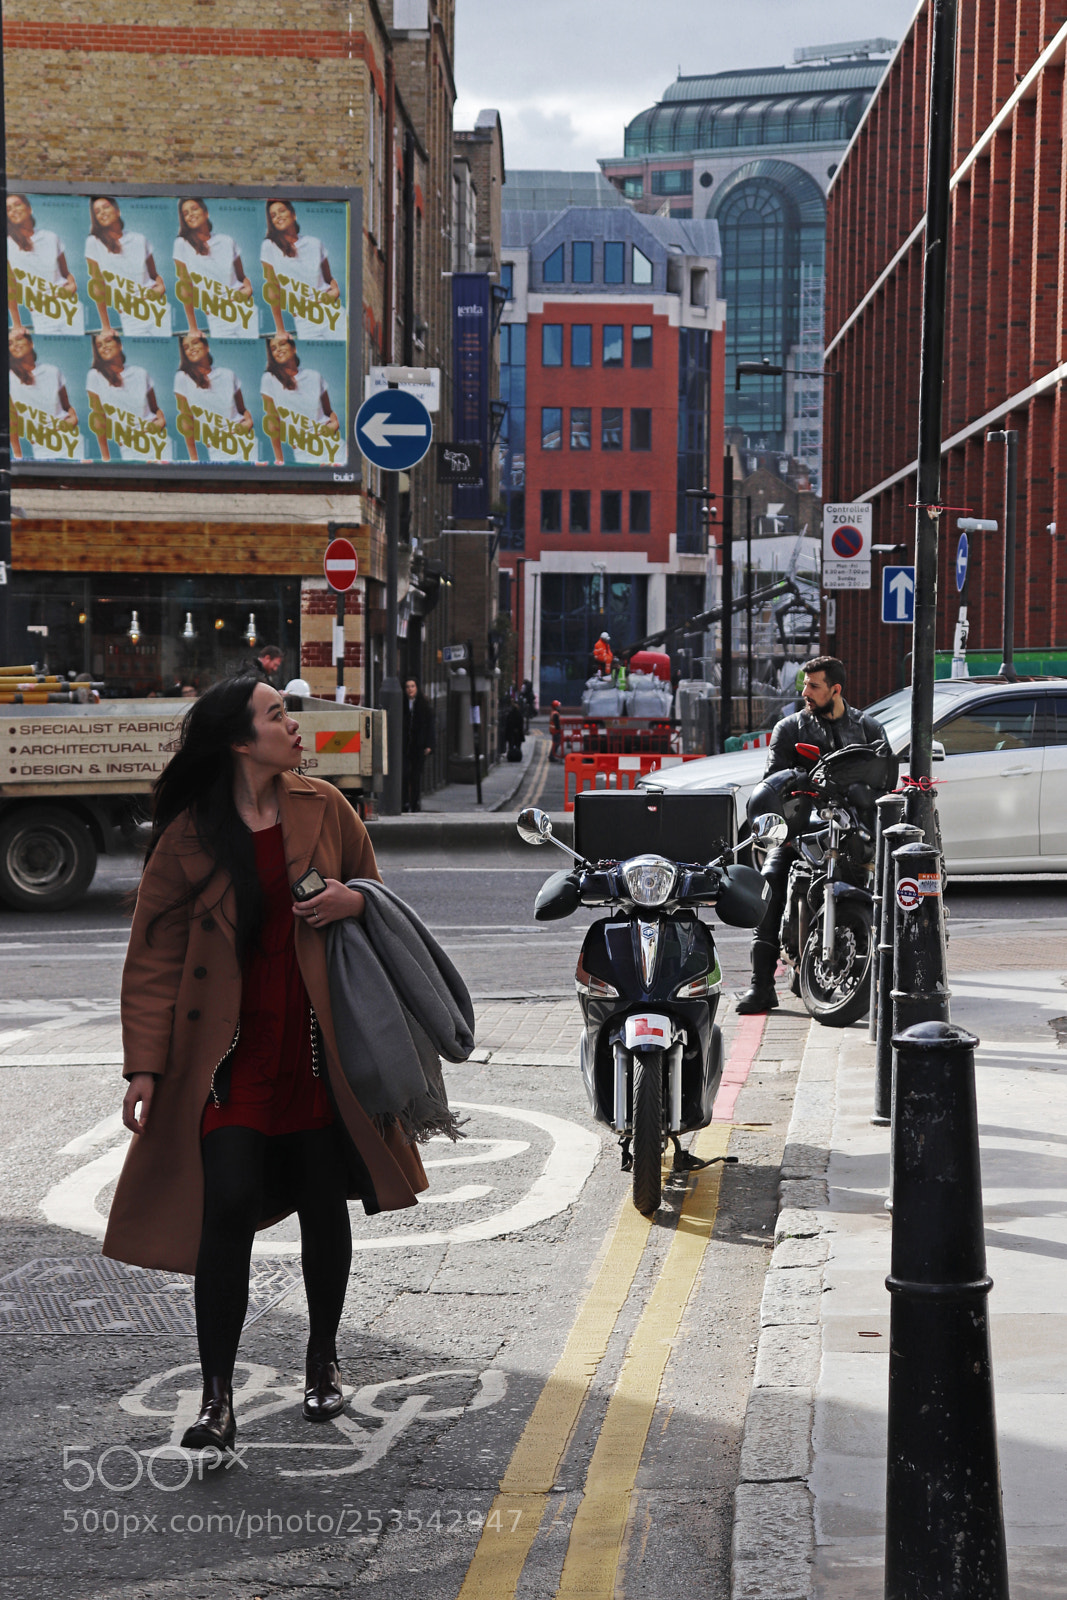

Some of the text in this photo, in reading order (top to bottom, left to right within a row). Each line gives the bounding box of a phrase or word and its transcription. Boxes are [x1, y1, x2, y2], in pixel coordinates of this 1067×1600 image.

[88, 278, 167, 328] CINDY
[175, 280, 254, 330] CINDY
[263, 282, 341, 331] CINDY
[88, 412, 167, 461] CINDY
[176, 413, 255, 461] CINDY
[262, 415, 340, 463] CINDY
[826, 505, 870, 513] Controlled
[832, 514, 863, 524] ZONE
[20, 723, 113, 735] SPECIALIST
[19, 742, 153, 755] ARCHITECTURAL
[20, 764, 83, 775] DESIGN
[88, 763, 102, 774] &
[635, 1018, 664, 1037] L
